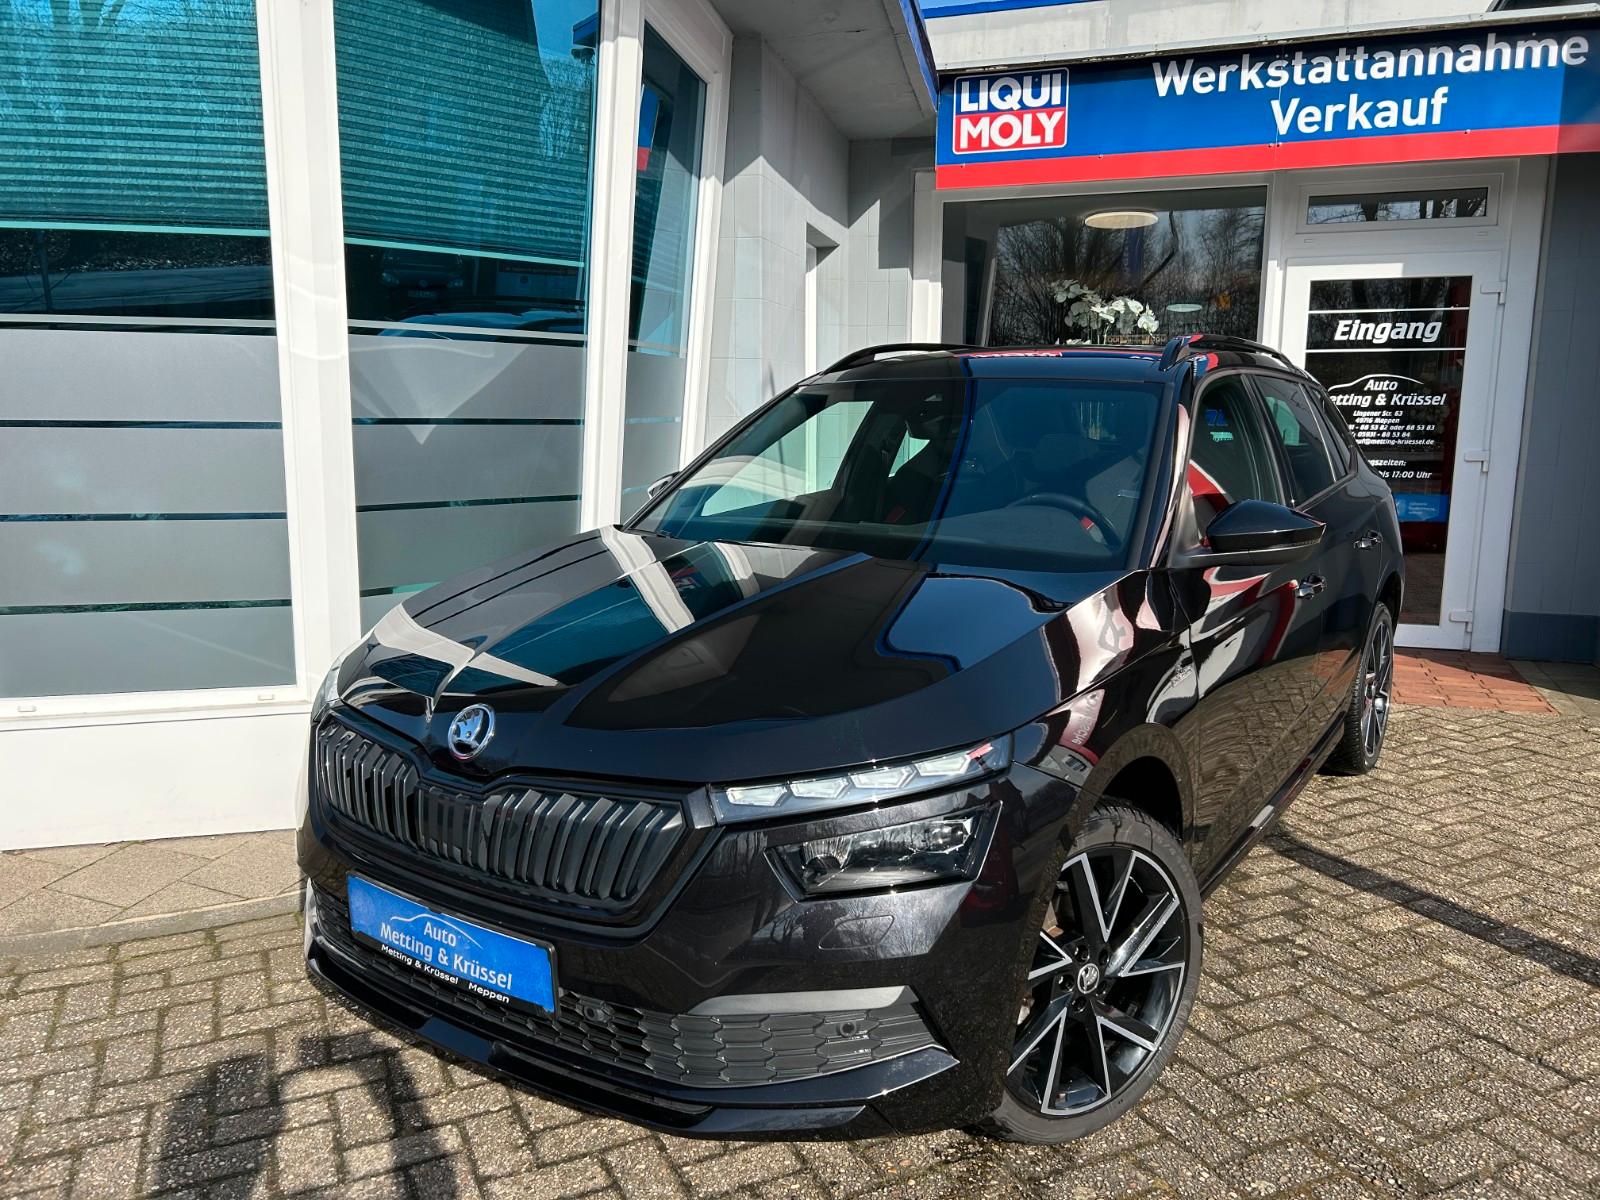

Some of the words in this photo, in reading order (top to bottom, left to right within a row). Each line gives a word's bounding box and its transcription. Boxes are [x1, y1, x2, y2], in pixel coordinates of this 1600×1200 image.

[1152, 33, 1589, 97] Werkstattannahme
[960, 73, 1062, 112] LIQUI
[1270, 86, 1449, 137] Verkauf
[960, 111, 1065, 149] MOLY
[1334, 319, 1443, 344] Eingang
[1330, 394, 1371, 408] etting
[1375, 393, 1387, 406] &
[1390, 393, 1447, 406] Krüssel
[1363, 379, 1398, 391] Auto
[1373, 417, 1400, 425] Meppen
[424, 921, 457, 947] Auto
[380, 922, 433, 962] Metting
[437, 947, 449, 966] &
[453, 953, 513, 990] Krüssel
[381, 944, 412, 966] Metting
[414, 959, 422, 969] &
[424, 964, 459, 985] Krüssel
[468, 982, 510, 1004] Meppen
